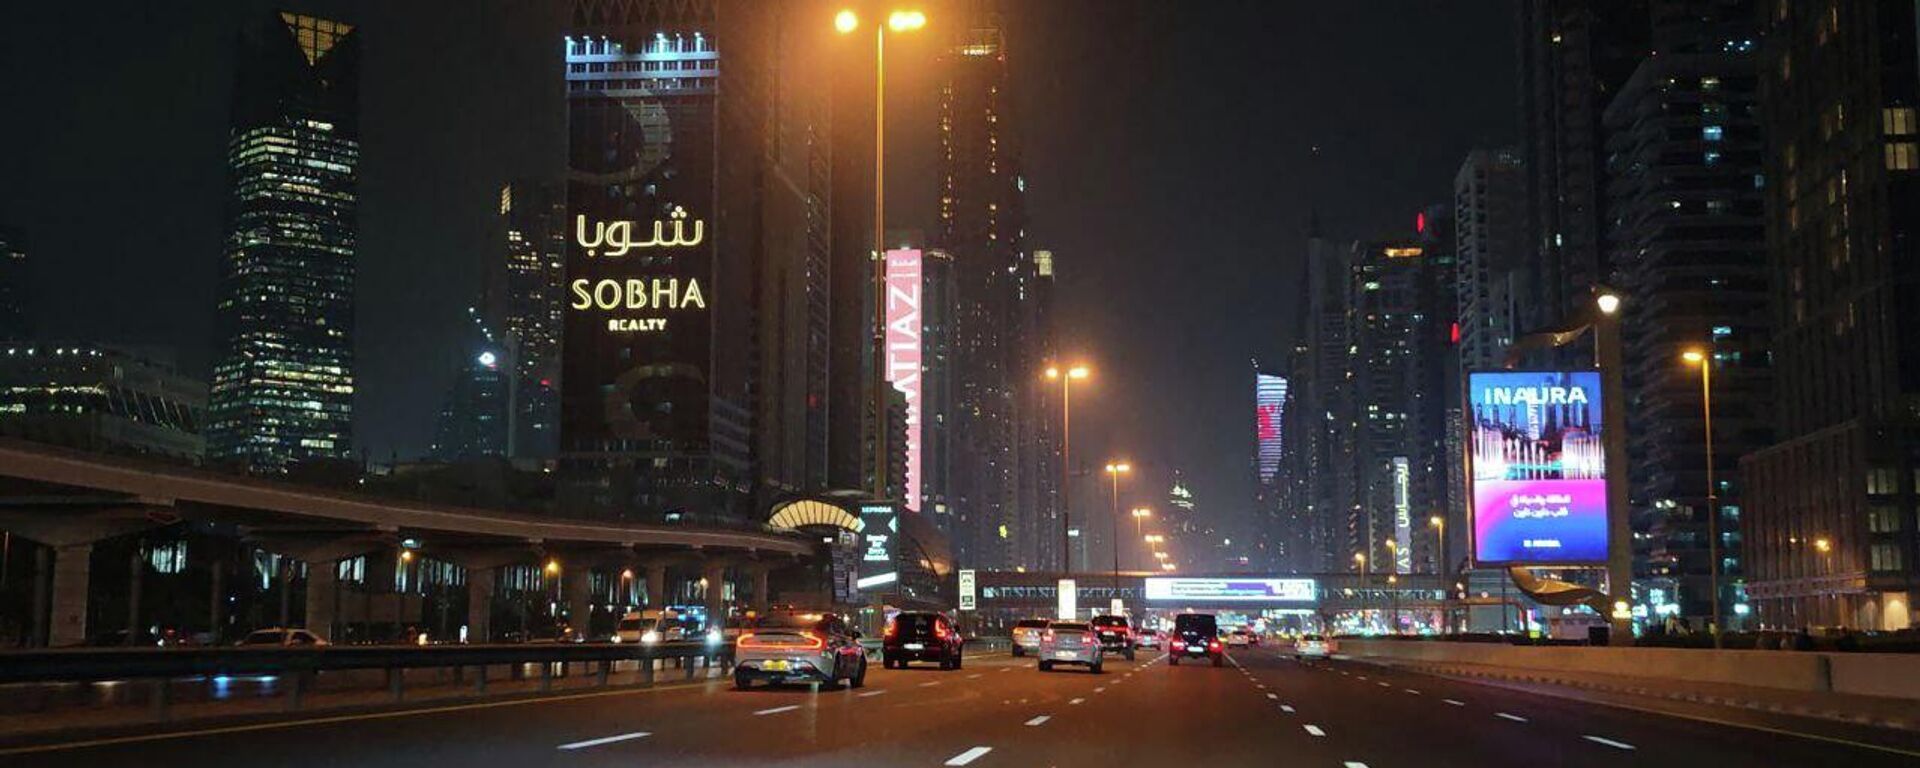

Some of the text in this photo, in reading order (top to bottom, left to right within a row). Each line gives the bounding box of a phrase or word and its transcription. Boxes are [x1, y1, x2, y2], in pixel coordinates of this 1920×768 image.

[576, 205, 704, 257] شوبا
[571, 278, 705, 310] SOBHA
[608, 318, 667, 331] REALTY
